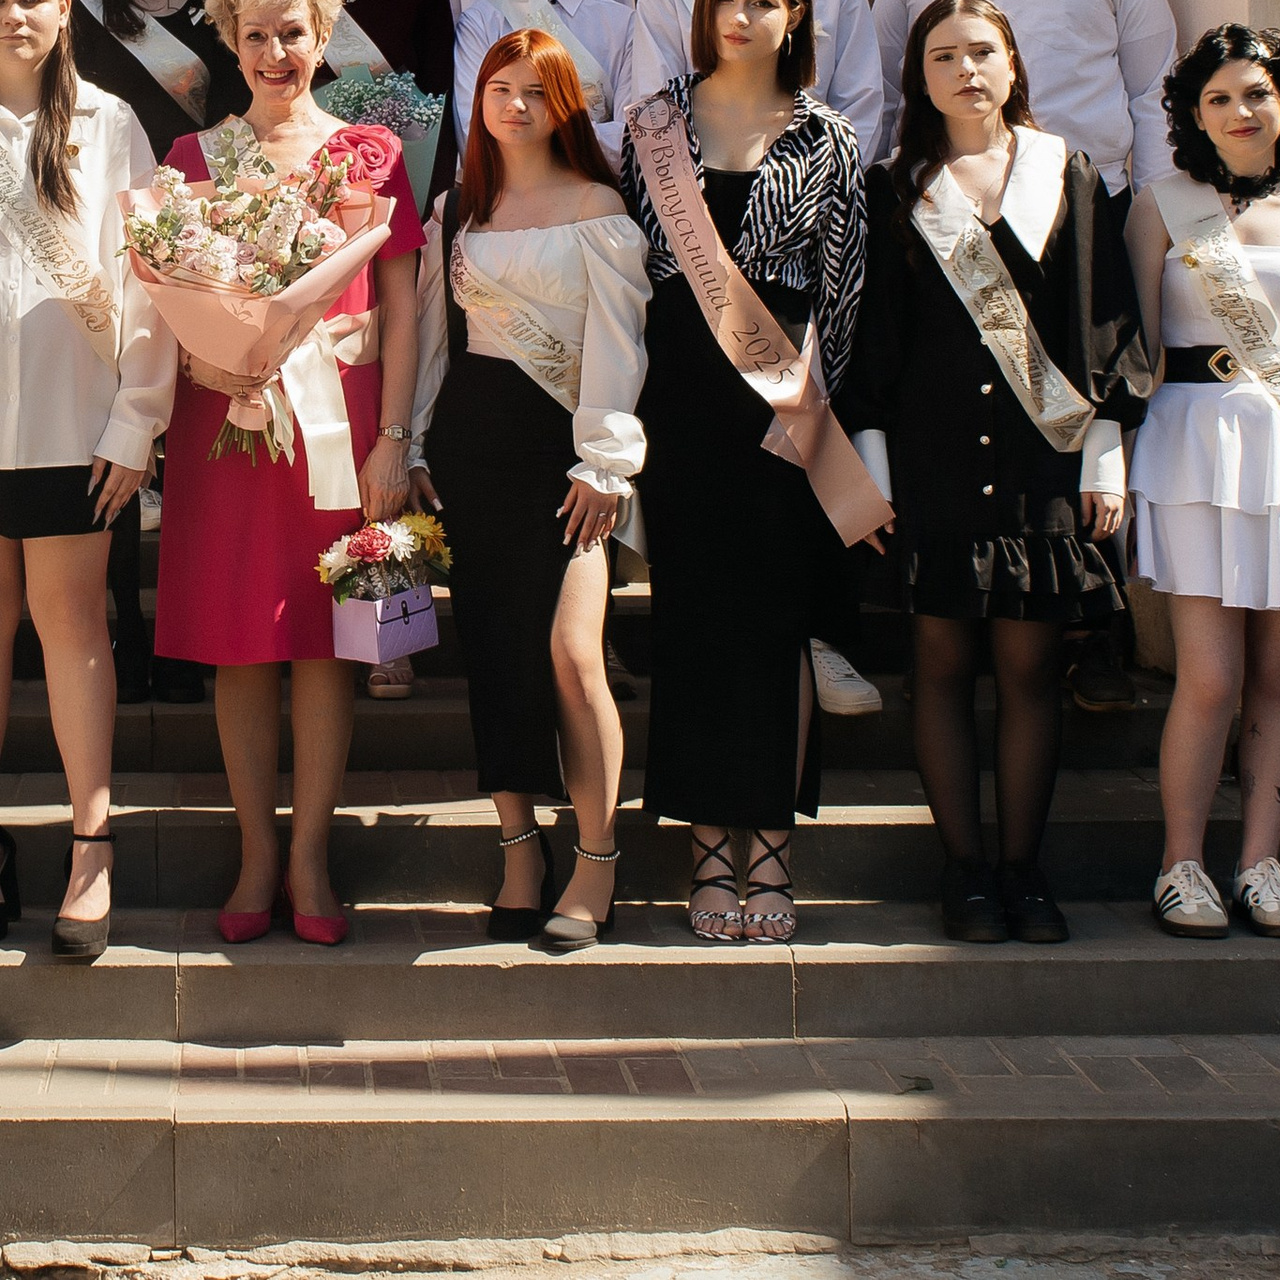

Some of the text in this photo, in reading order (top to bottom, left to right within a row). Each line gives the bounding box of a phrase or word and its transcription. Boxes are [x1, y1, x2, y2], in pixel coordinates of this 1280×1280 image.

[51, 258, 121, 333] 2025
[650, 138, 795, 385] Выпускница 2025
